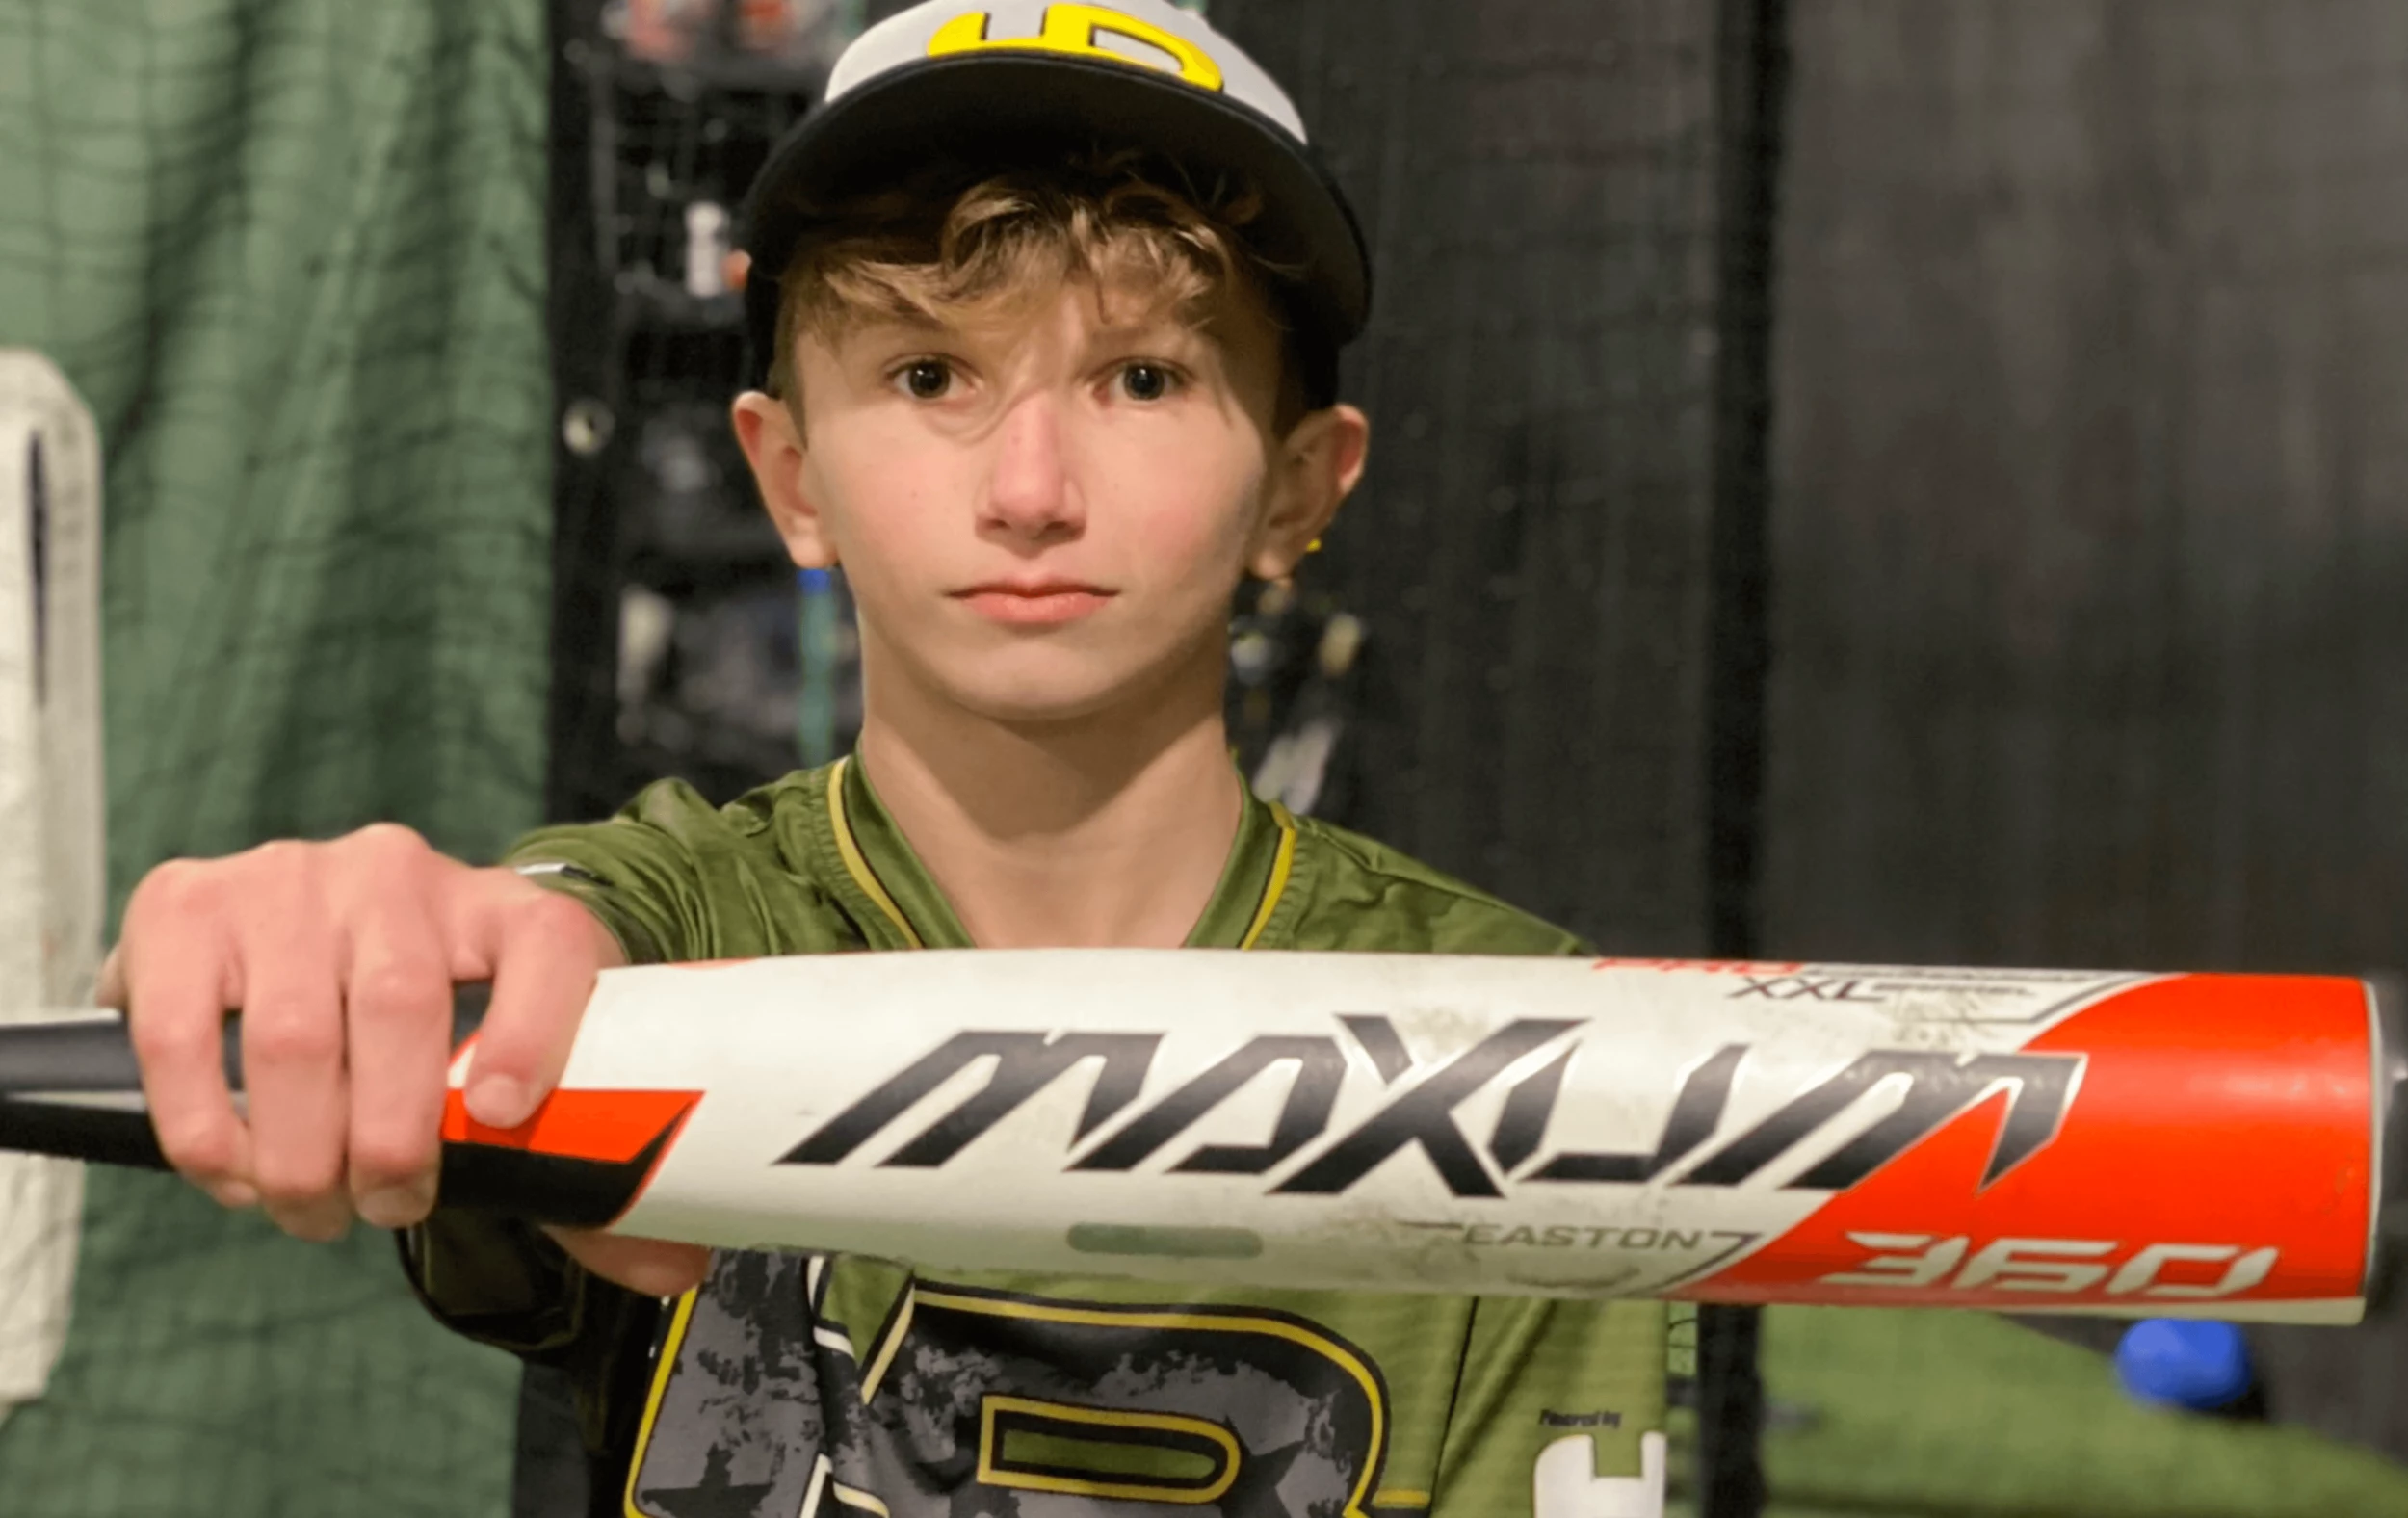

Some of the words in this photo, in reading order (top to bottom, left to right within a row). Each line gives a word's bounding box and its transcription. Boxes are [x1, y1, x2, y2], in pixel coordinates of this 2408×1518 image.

[1726, 975, 1886, 1003] XXL
[771, 1012, 2088, 1200] MAXUM
[1462, 1223, 1703, 1250] EASTON
[1819, 1231, 2280, 1297] 360
